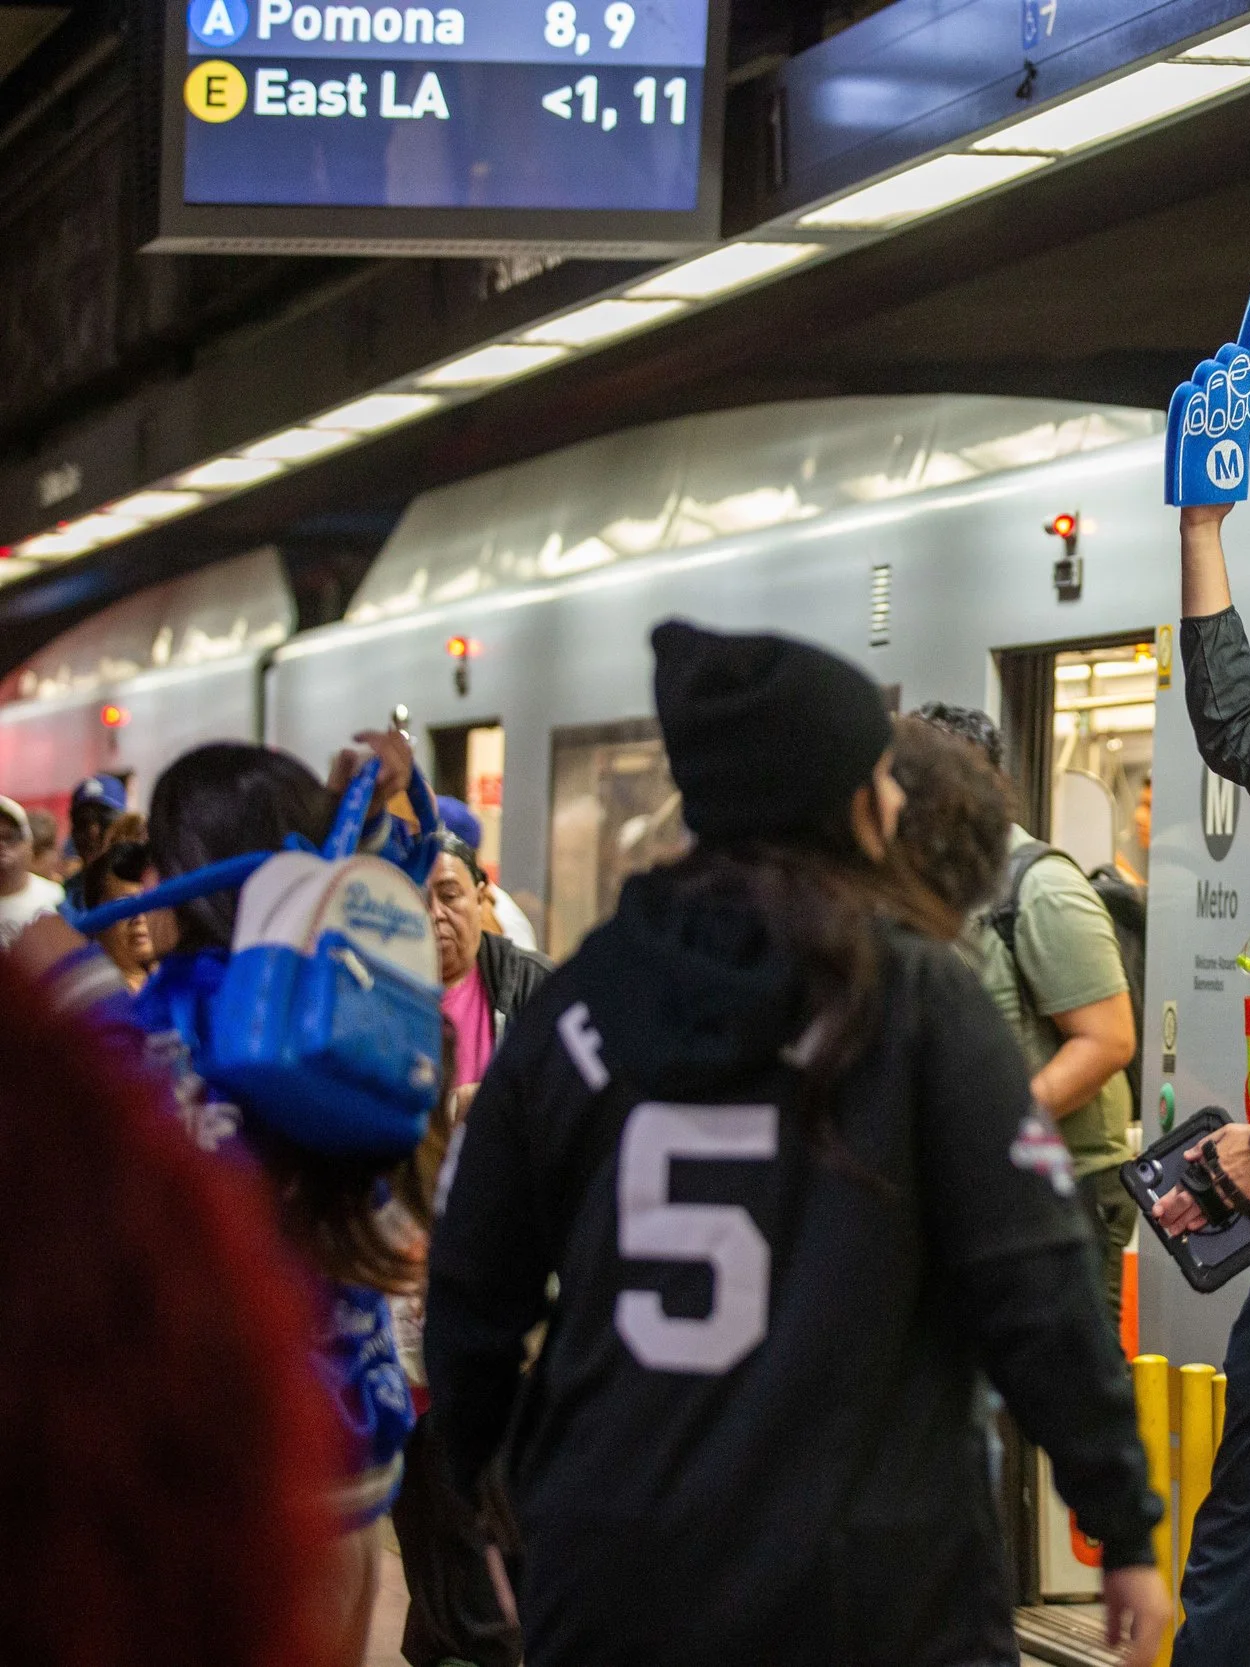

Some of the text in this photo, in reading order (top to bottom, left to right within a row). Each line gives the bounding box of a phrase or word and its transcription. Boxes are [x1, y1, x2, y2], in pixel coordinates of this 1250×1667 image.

[201, 0, 636, 56] A Pomona 8, 9
[205, 67, 687, 132] E East LA <1, 11
[1214, 447, 1240, 481] M
[1196, 879, 1239, 920] Metro
[613, 1101, 780, 1377] 5
